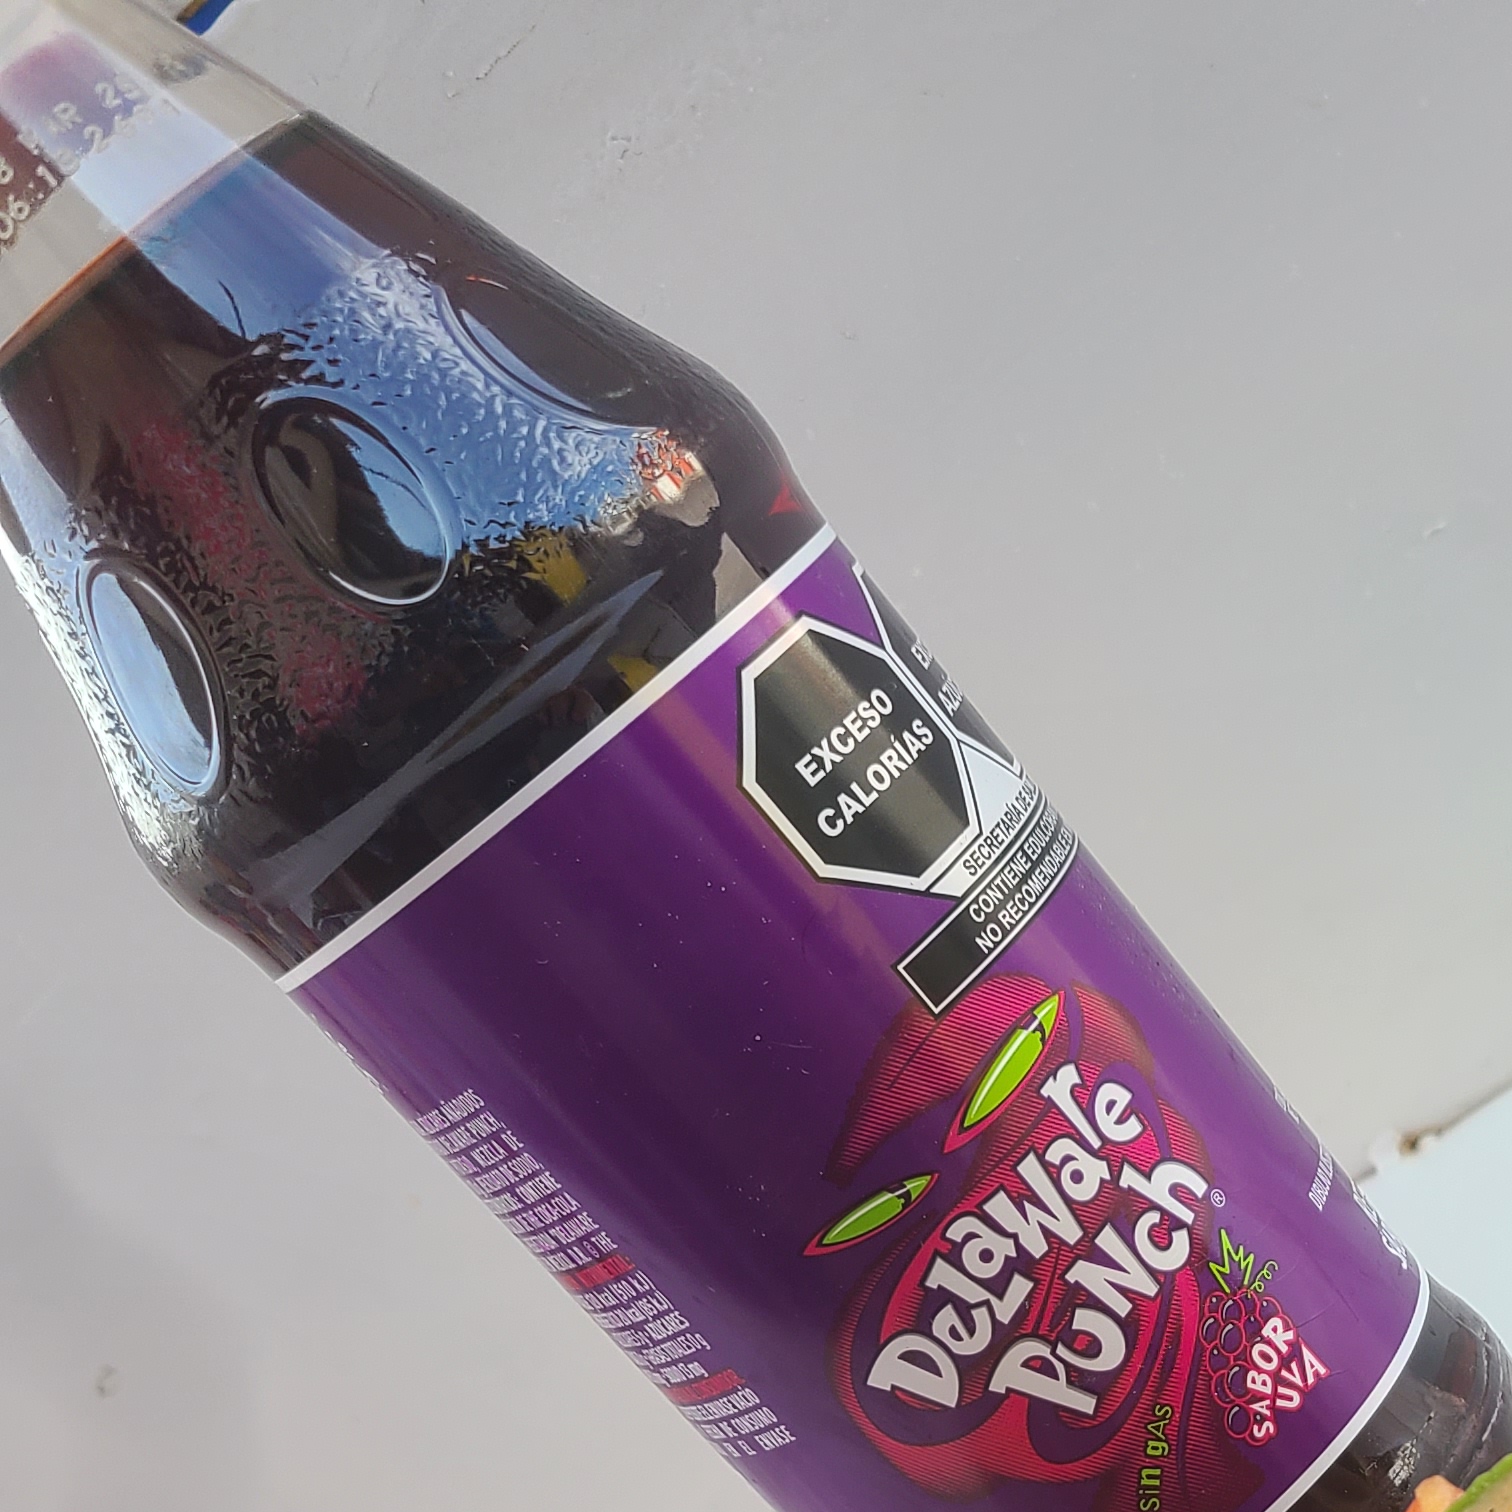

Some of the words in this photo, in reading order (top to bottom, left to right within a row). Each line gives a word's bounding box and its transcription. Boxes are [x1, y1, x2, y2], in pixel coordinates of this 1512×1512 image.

[794, 688, 894, 788] EXCESO
[817, 718, 934, 838] CALORÍAS
[962, 802, 1025, 877] SECRETARÍA
[969, 851, 1032, 923] CONTIENE
[975, 922, 1003, 954] NO
[997, 833, 1071, 931] RECOMENDABLE
[470, 1140, 509, 1168] MEZCLA
[500, 1130, 524, 1151] DE
[514, 1170, 562, 1205] CONTIENE
[532, 1191, 582, 1225] COCA-COLA
[590, 1231, 619, 1254] THE
[727, 1384, 761, 1411] VACÍO
[1247, 1317, 1294, 1438] SABOR
[1275, 1344, 1327, 1409] UVA
[730, 1406, 779, 1435] CONSUMO
[737, 1439, 757, 1456] EL
[754, 1424, 797, 1451] ENVASE
